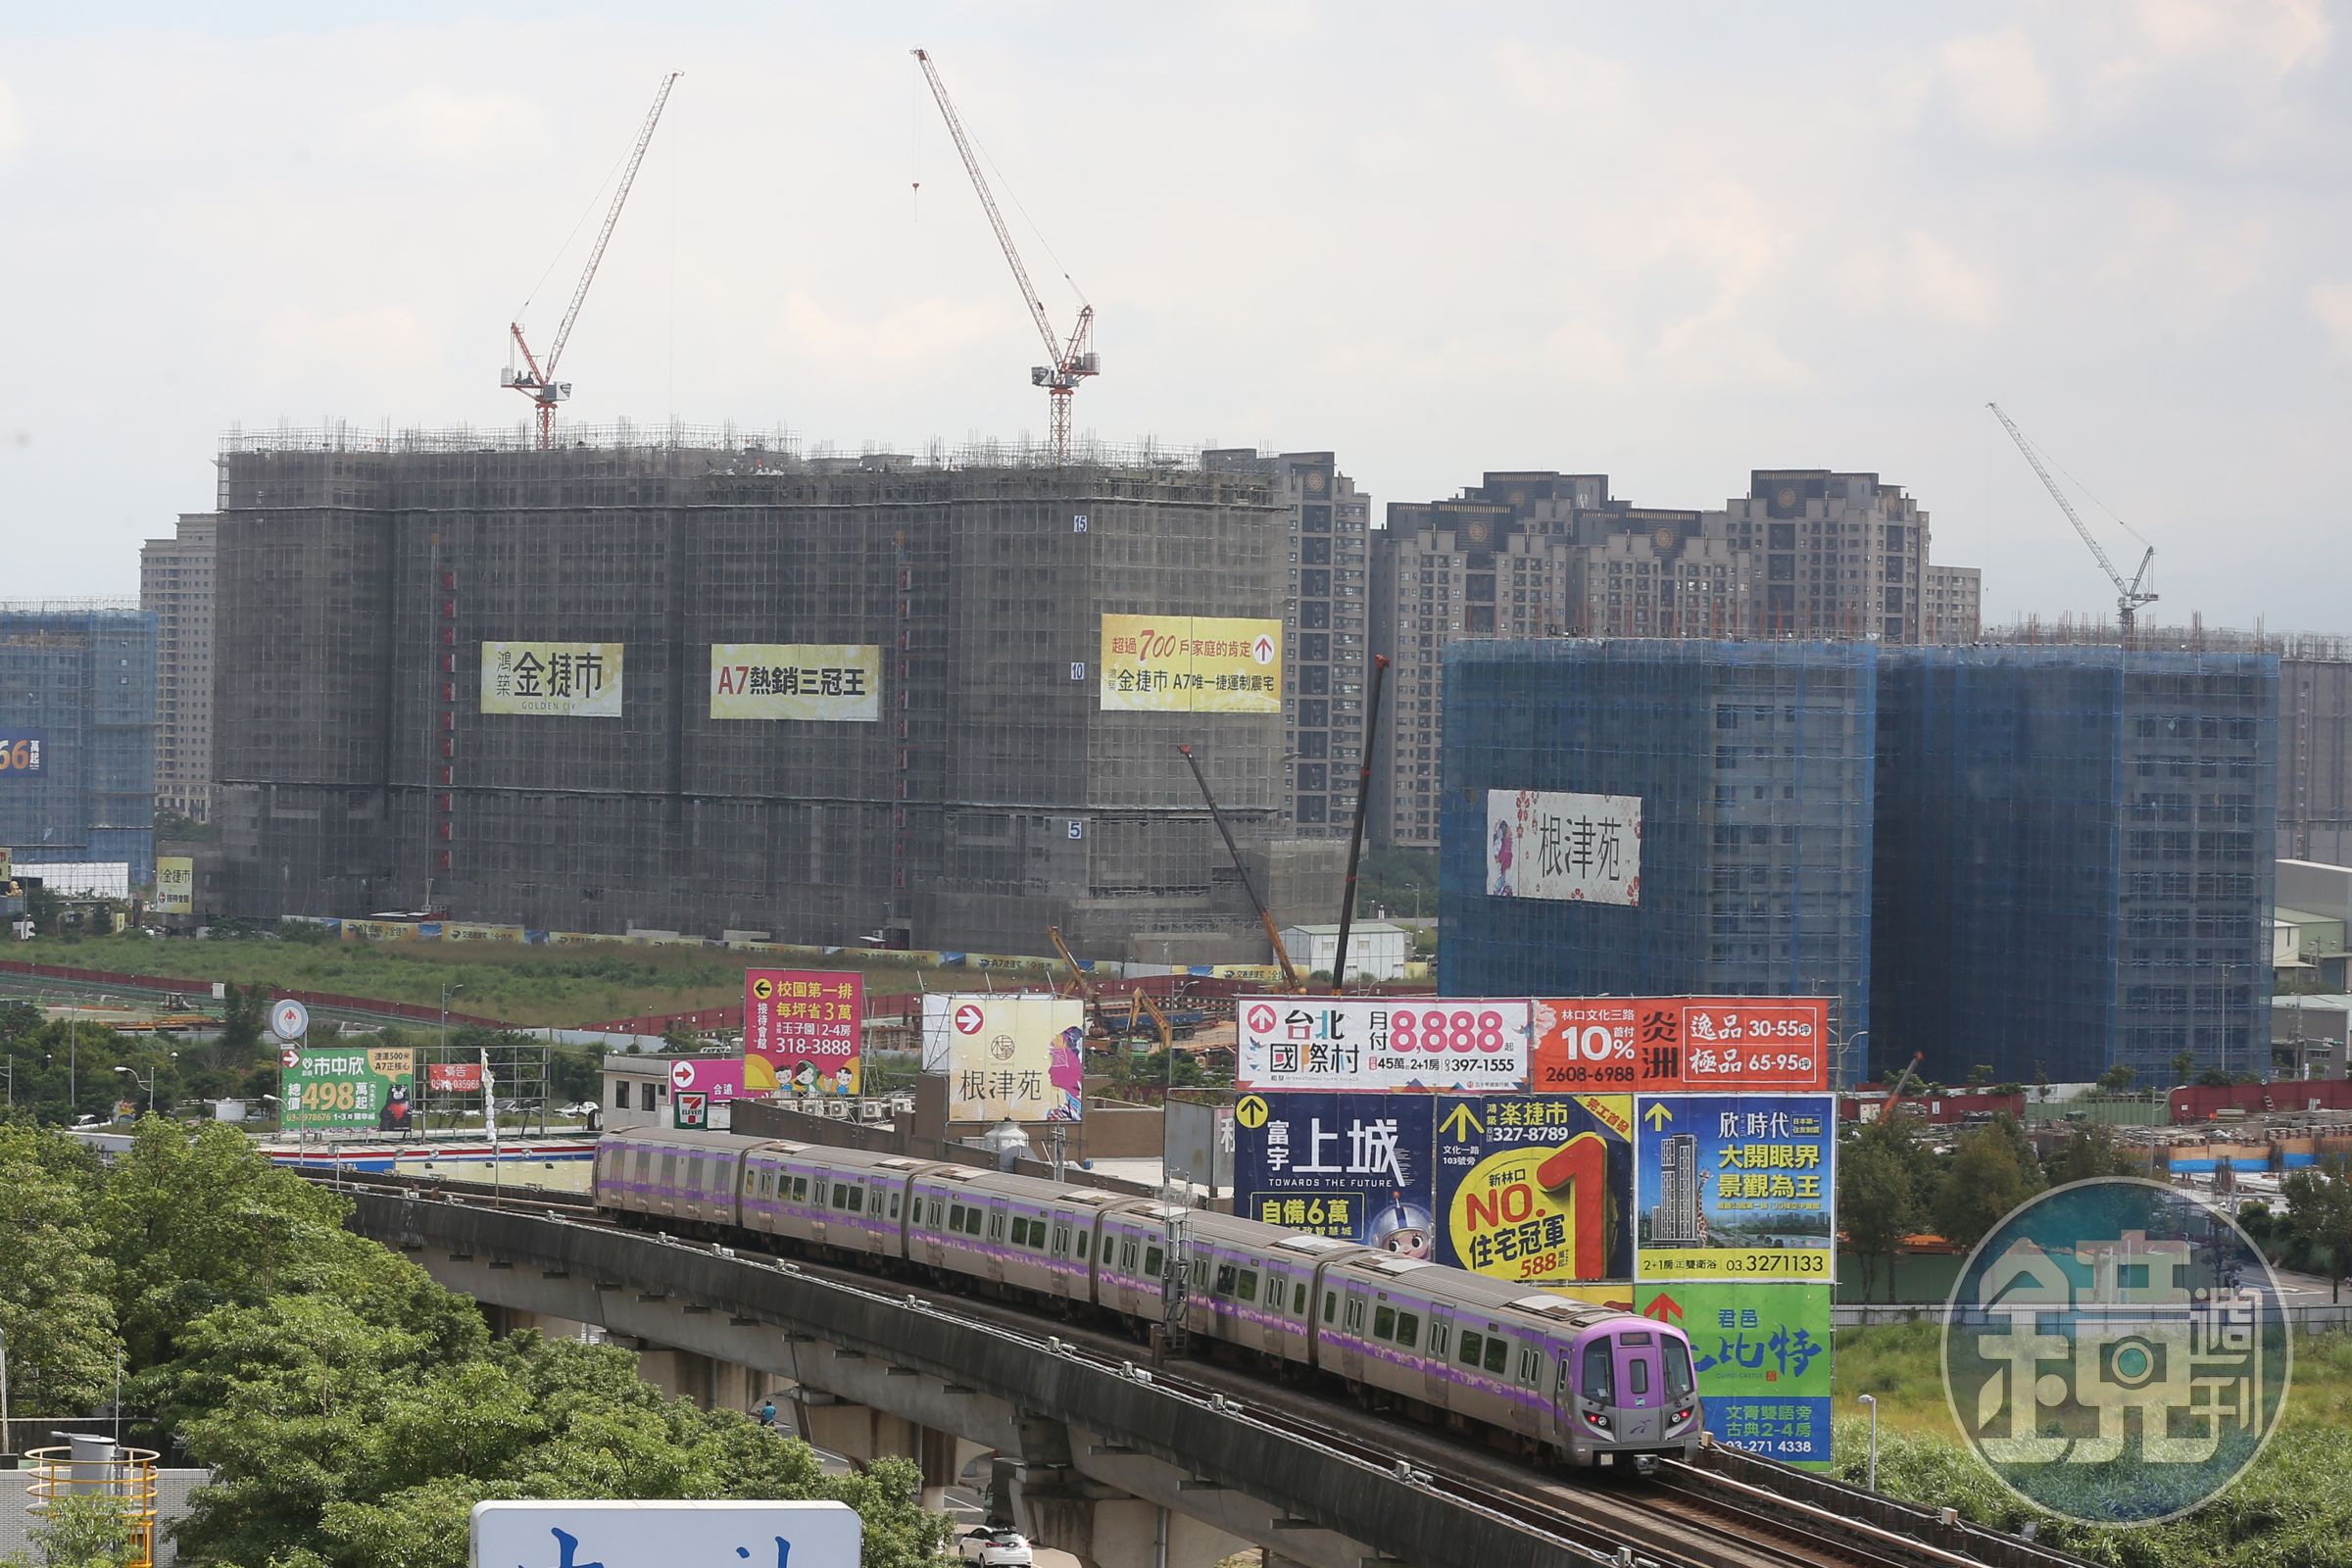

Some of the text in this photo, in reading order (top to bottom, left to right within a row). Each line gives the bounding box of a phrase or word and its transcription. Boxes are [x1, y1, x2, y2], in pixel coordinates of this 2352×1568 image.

[1075, 516, 1086, 531] 15
[497, 651, 511, 697] 鴻築
[513, 651, 603, 699] 金捷市
[717, 665, 865, 696] A7熱銷三冠王
[1072, 664, 1083, 679] 10
[1117, 668, 1168, 693] 金捷市
[521, 701, 559, 710] GOLDEN
[1070, 822, 1080, 838] 5
[1537, 812, 1622, 881] 根津苑
[777, 981, 853, 1000] 校園第一排
[776, 1002, 853, 1021] 每坪省3萬
[1561, 1009, 1636, 1021] 林口文化三路
[757, 1003, 768, 1050] 接待會館
[1285, 1009, 1346, 1040] 台北
[1369, 1011, 1388, 1052] 月付
[1390, 1010, 1504, 1054] 8,888
[1690, 1012, 1742, 1041] 逸品
[775, 1037, 852, 1055] 318-3888
[1642, 1011, 1679, 1079] 炎洲
[315, 1056, 365, 1076] 市中欣
[1270, 1043, 1359, 1074] 國際村
[1451, 1058, 1515, 1072] 397-1555
[1689, 1048, 1742, 1075] 極品
[958, 1069, 1043, 1102] 根津苑
[1545, 1066, 1636, 1082] 2608-6988
[287, 1082, 301, 1110] 總價
[302, 1082, 355, 1110] 498
[355, 1082, 368, 1109] 萬起
[1494, 1127, 1568, 1142] 327-8789
[1718, 1112, 1789, 1139] 欣時代
[1267, 1120, 1290, 1171] 富宇
[1292, 1118, 1405, 1187] 上城
[1443, 1146, 1480, 1154] 文化一路
[1718, 1144, 1820, 1169] 大開眼界
[1489, 1169, 1526, 1187] 新林口
[1717, 1174, 1820, 1199] 景觀為王
[1262, 1199, 1349, 1224] 自備6萬
[1469, 1214, 1566, 1270] 住宅冠軍
[1520, 1252, 1557, 1278] 588
[1718, 1309, 1758, 1329] 君邑
[1726, 1422, 1812, 1438] 古典2-4房
[1778, 1441, 1811, 1452] 4338
